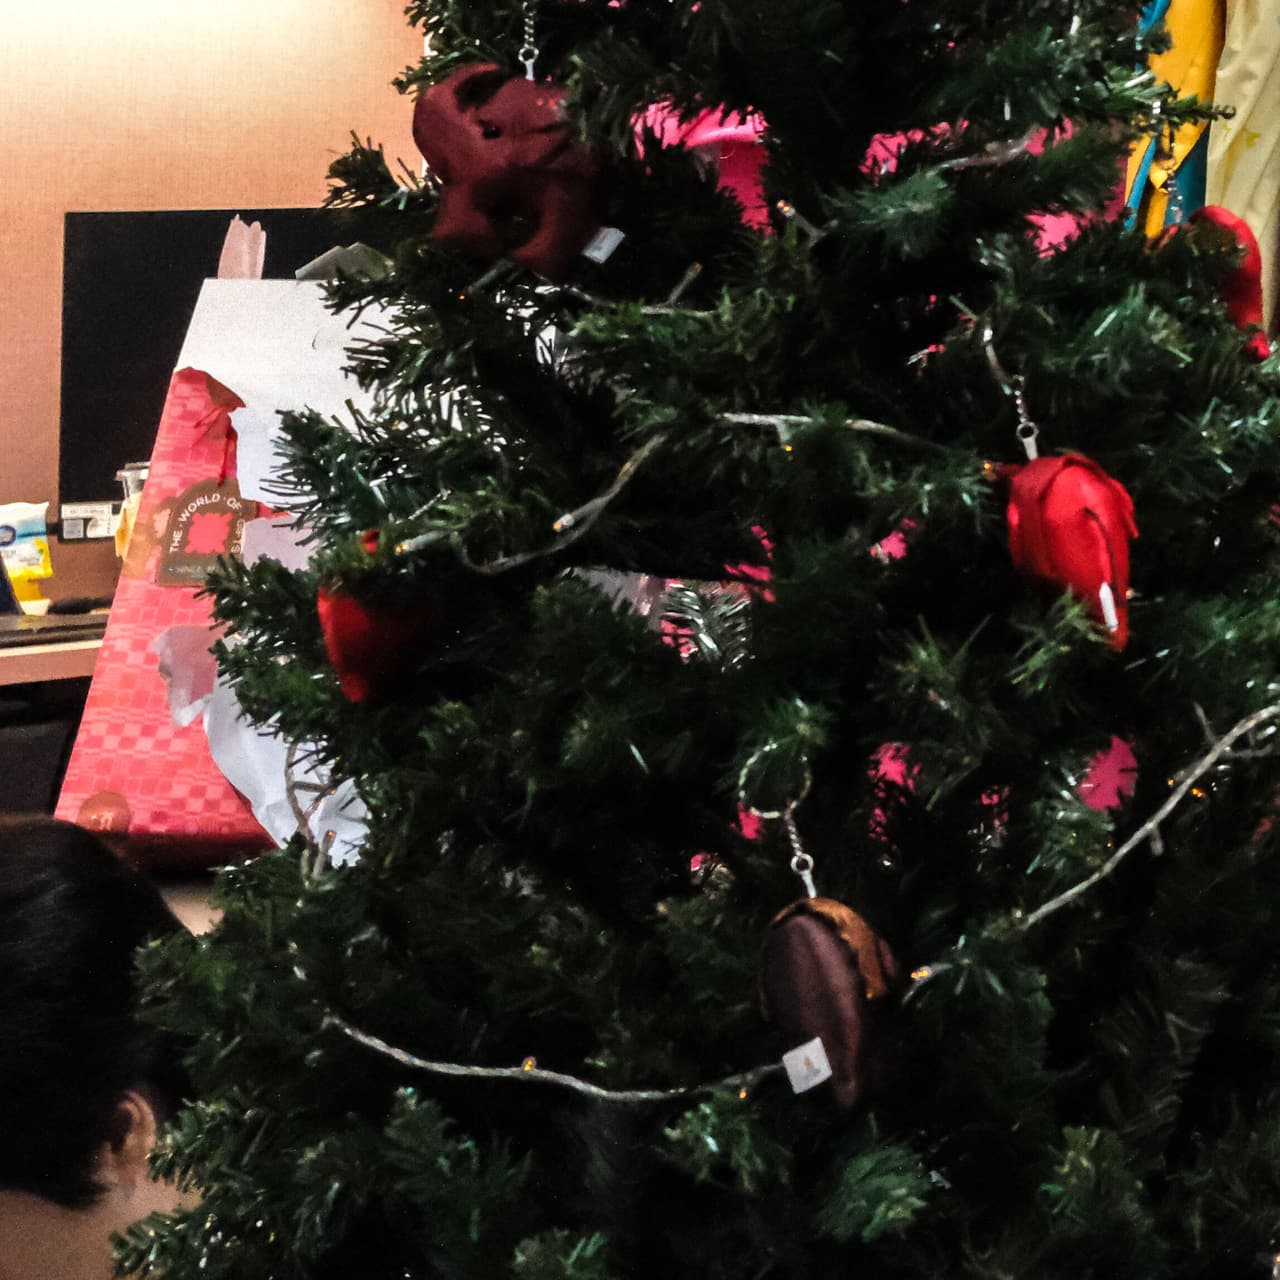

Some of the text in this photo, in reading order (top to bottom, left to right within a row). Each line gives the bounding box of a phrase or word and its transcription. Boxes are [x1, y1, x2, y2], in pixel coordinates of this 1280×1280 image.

[169, 530, 183, 553] THE
[177, 493, 221, 522] WORLD
[226, 497, 243, 510] OF
